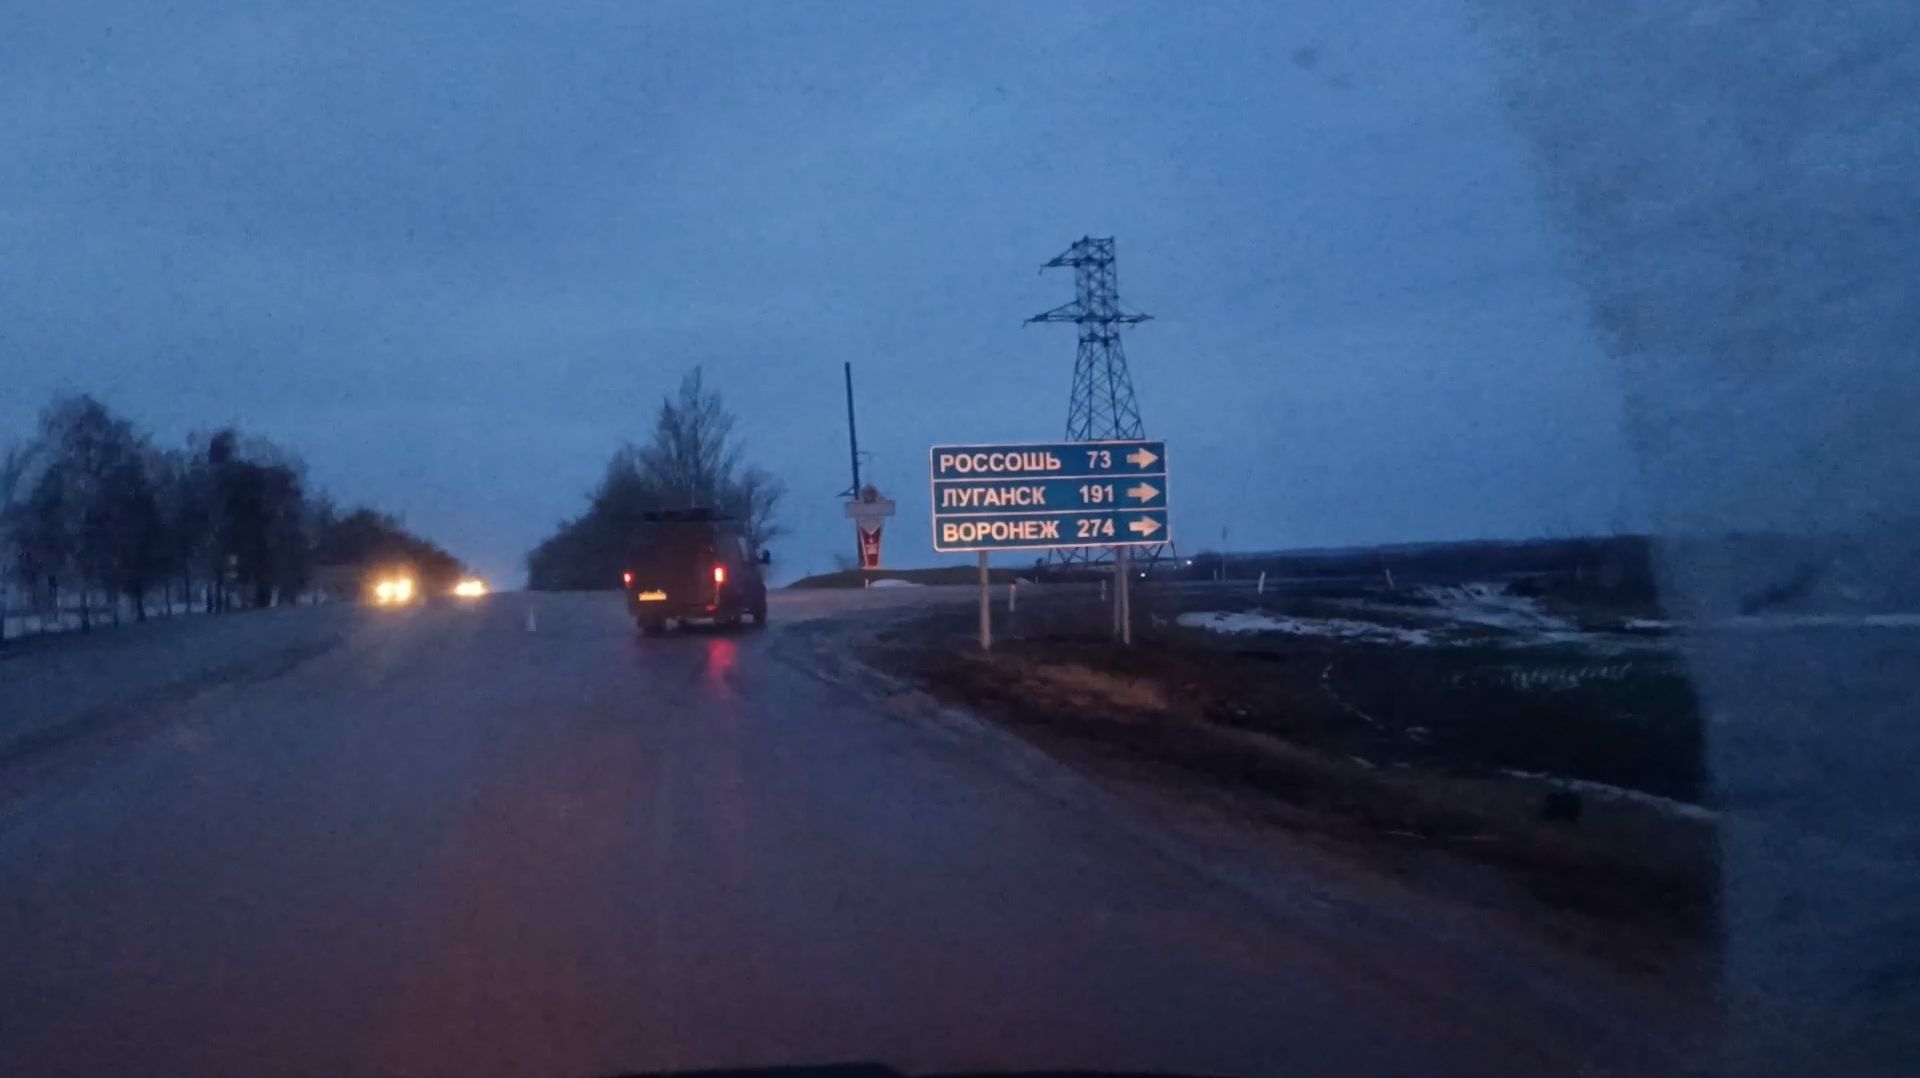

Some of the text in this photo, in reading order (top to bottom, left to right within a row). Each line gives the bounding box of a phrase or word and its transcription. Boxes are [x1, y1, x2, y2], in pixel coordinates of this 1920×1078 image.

[940, 450, 1112, 473] РОССОШЬ 73
[942, 484, 1113, 507] ЛУГАНСК 191
[943, 518, 1115, 542] ВОРОНЕЖ 274
